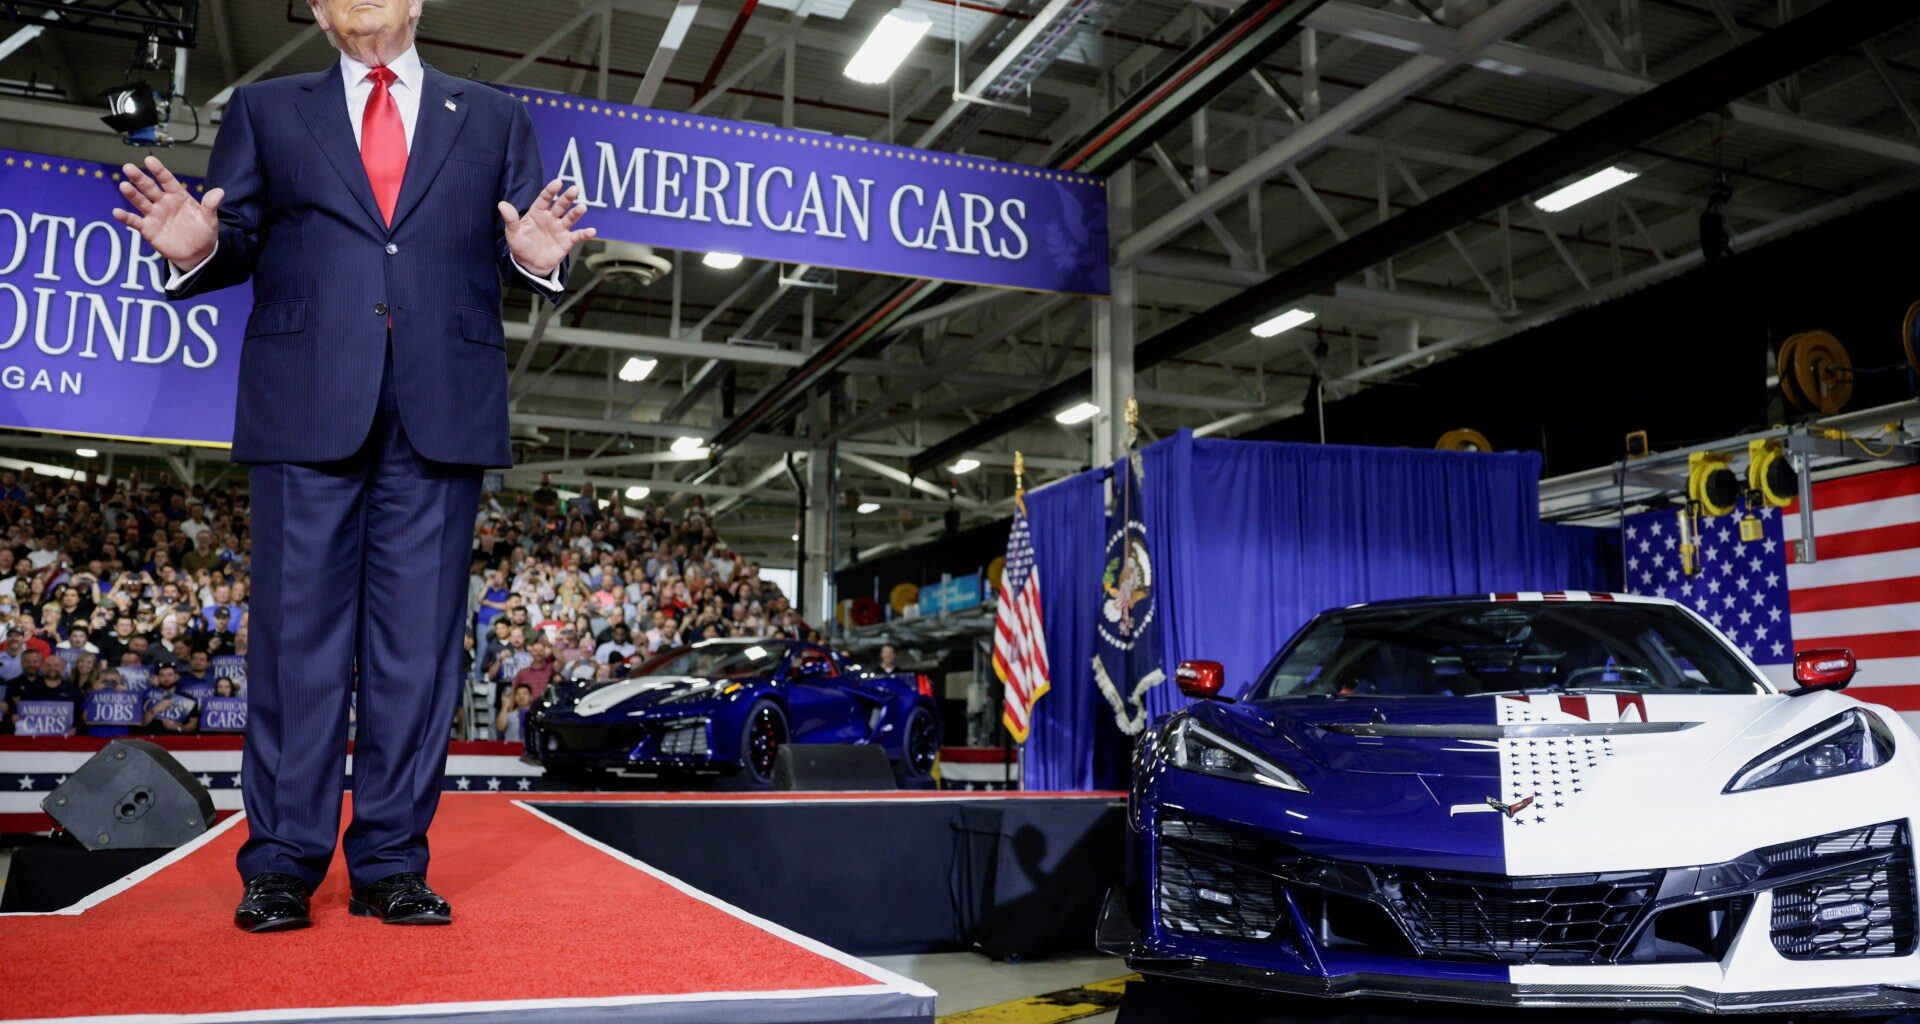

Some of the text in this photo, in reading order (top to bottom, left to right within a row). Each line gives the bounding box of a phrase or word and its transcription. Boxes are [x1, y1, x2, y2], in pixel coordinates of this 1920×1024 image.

[553, 136, 1029, 260] AMERICAN CARS
[1, 365, 83, 395] GAN
[214, 665, 246, 679] JOBS
[92, 693, 138, 703] AMERICAN
[206, 700, 247, 711] AMERICAN
[21, 704, 69, 715] AMERICAN
[94, 703, 134, 721] JOBS
[22, 715, 66, 733] CARS
[207, 711, 247, 728] CARS
